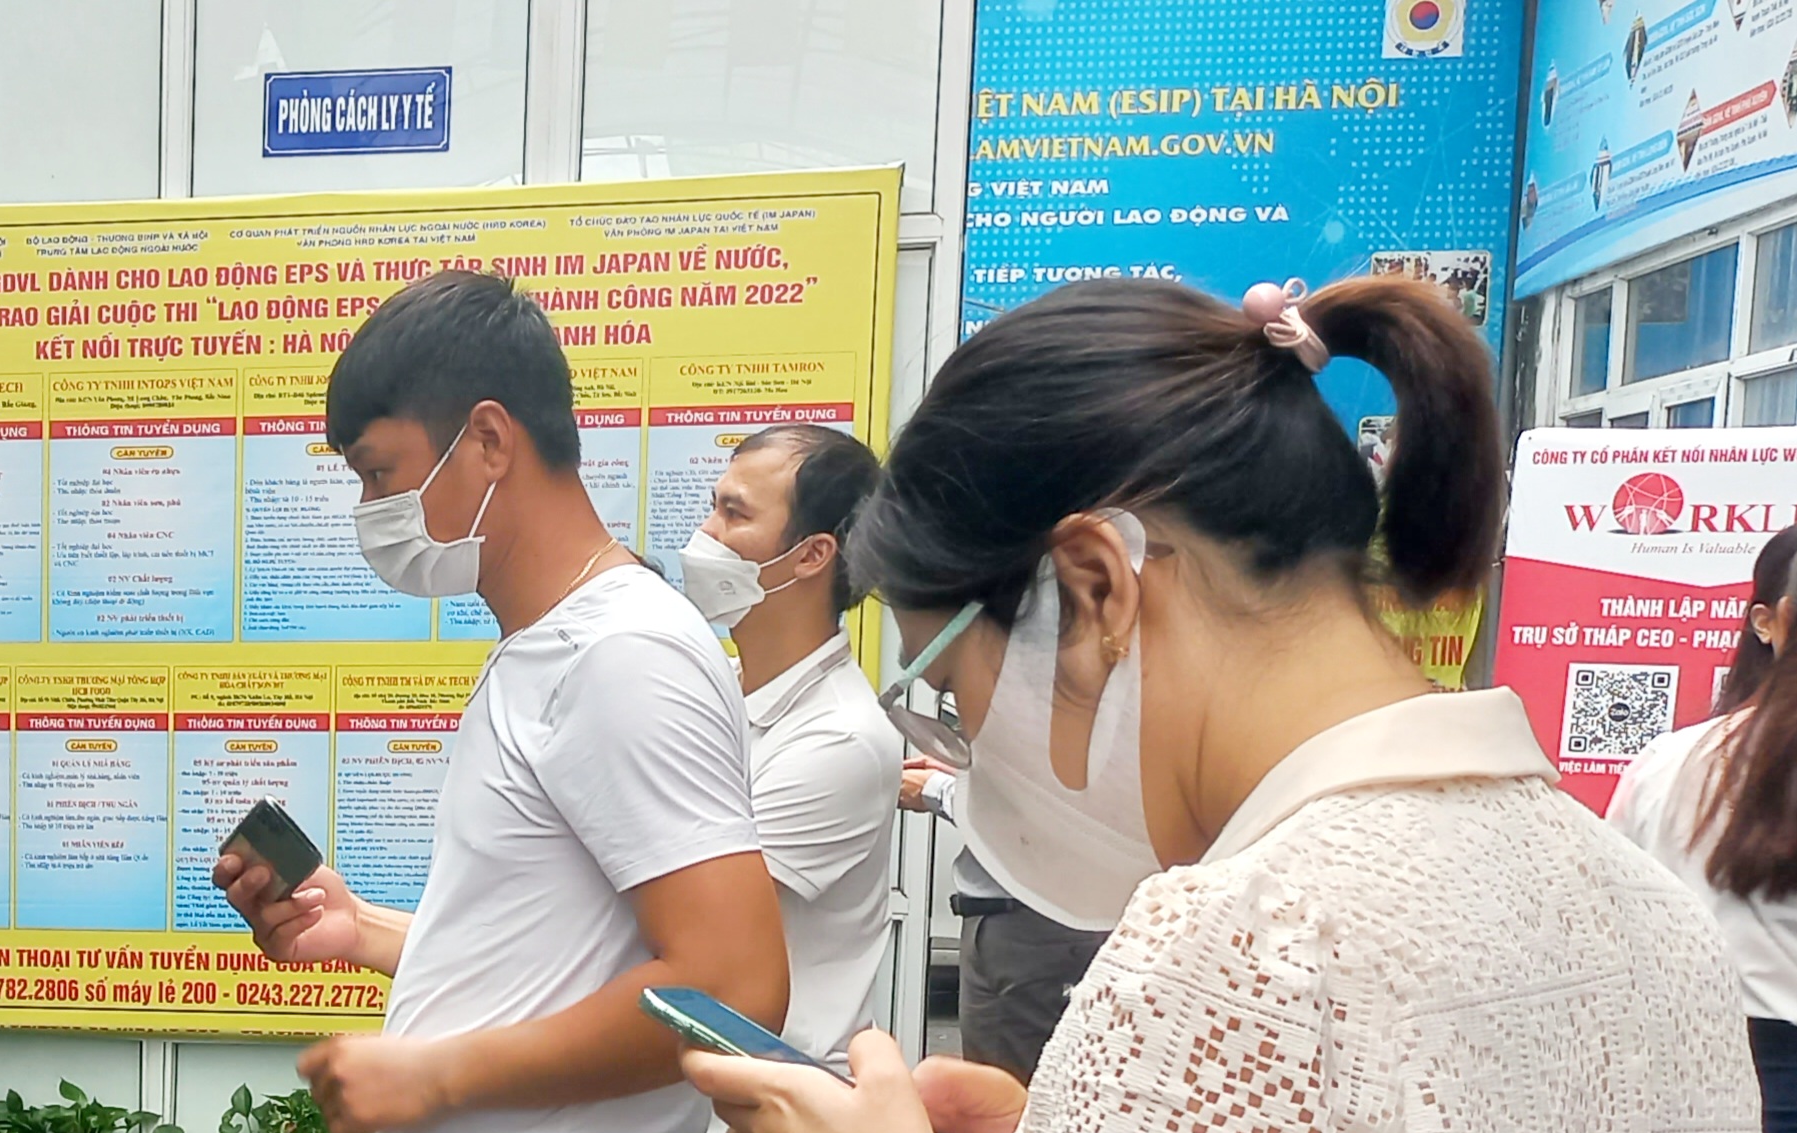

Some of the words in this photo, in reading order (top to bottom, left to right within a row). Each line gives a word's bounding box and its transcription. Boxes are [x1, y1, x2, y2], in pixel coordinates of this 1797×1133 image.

[278, 89, 332, 134] PHÒNG
[335, 89, 377, 132] CÁCH
[381, 95, 399, 131] LY
[402, 94, 414, 130] Y
[977, 88, 1014, 125] ỆT
[1022, 92, 1100, 118] NAM
[1109, 89, 1202, 119] (ESIP)
[1212, 86, 1265, 118] TẠI
[1274, 79, 1322, 111] HÀ
[1332, 78, 1400, 115] NỘI
[969, 131, 1275, 160] AMVIETNAM.GOV.VN
[991, 180, 1043, 200] VIỆT
[1051, 179, 1110, 196] NAM
[1021, 206, 1105, 227] NGƯỜI
[1114, 208, 1162, 225] LAO
[1170, 206, 1247, 227] ĐỘNG
[1255, 202, 1290, 222] VÀ
[49, 267, 108, 293] DÀNH
[116, 269, 160, 290] CHO
[168, 266, 208, 288] LAO
[215, 262, 278, 291] ĐỘNG
[285, 262, 329, 285] EPS
[337, 257, 366, 283] VÀ
[555, 255, 584, 276] IM
[592, 251, 671, 275] JAPAN
[679, 243, 708, 272] VỀ
[715, 243, 790, 271] NƯỚC,
[46, 298, 90, 326] GIẢI
[98, 300, 157, 329] CUỘC
[164, 302, 198, 323] THI
[266, 295, 329, 324] ĐỘNG
[336, 296, 380, 317] EPS
[524, 286, 599, 311] HÀNH
[607, 284, 673, 310] CÔNG
[681, 281, 736, 307] NĂM
[35, 334, 75, 361] KẾT
[82, 331, 121, 359] NỐI
[127, 336, 183, 362] TRỰC
[191, 329, 262, 357] TUYẾN
[283, 331, 313, 354] HÀ
[604, 320, 652, 346] HÓA
[1532, 448, 1568, 465] CÔNG
[1572, 451, 1587, 464] TY
[1653, 446, 1676, 464] KẾT
[1681, 445, 1704, 463] NỐI
[1710, 447, 1747, 462] NHÂN
[1753, 447, 1779, 462] LỰC
[1631, 542, 1678, 554] Human
[1682, 543, 1693, 553] Is
[1698, 542, 1756, 555] Valuable
[1601, 595, 1663, 618] THÀNH
[1668, 595, 1705, 621] LẬP
[1430, 636, 1464, 666] TIN
[1512, 626, 1546, 650] TRỤ
[1552, 622, 1578, 646] SỞ
[1583, 624, 1632, 647] THÁP
[1637, 628, 1675, 648] CEO
[16, 948, 70, 972] THOẠI
[76, 948, 102, 969] TƯ
[106, 944, 143, 969] VẤN
[150, 945, 210, 971] TUYỂN
[216, 952, 269, 975] DỤNG
[85, 976, 109, 1003] số
[113, 980, 152, 1006] máy
[159, 979, 176, 1003] lẻ
[182, 981, 216, 1004] 200
